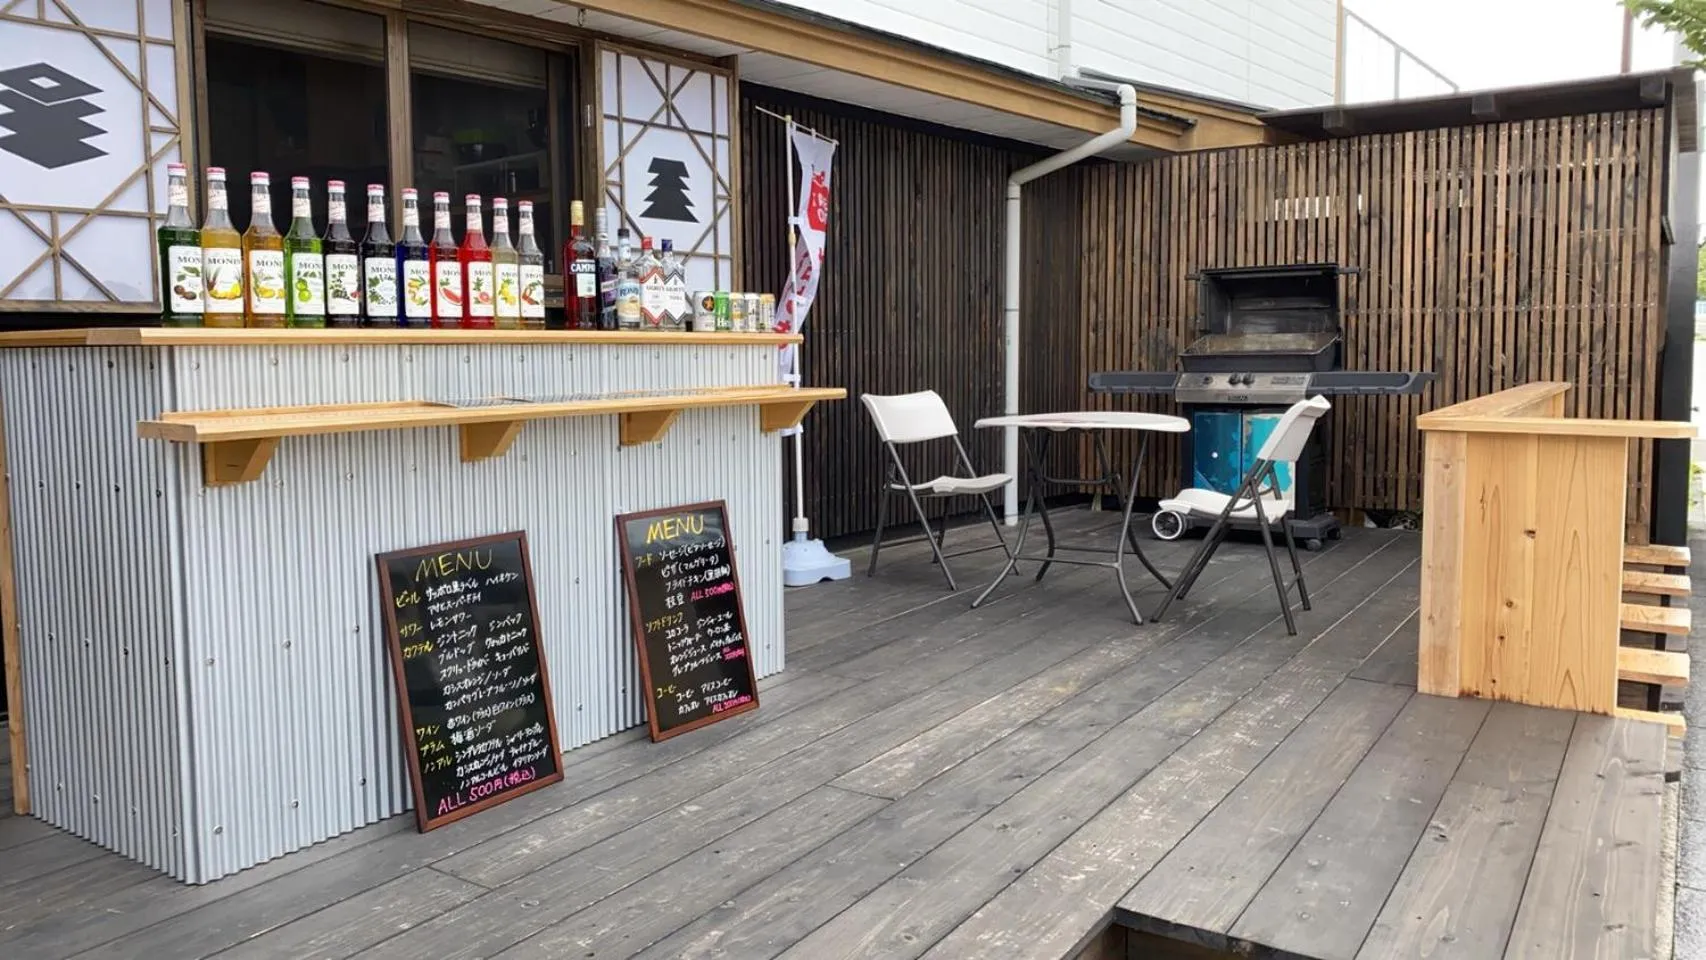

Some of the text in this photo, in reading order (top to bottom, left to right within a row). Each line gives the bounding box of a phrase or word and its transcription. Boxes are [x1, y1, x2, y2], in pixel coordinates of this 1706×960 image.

[570, 263, 596, 272] CAMP
[646, 514, 704, 544] MENU
[415, 549, 492, 582] MENU
[396, 590, 421, 608] ビール
[400, 612, 472, 638] サワー レモンサワー
[438, 792, 466, 815] ALL
